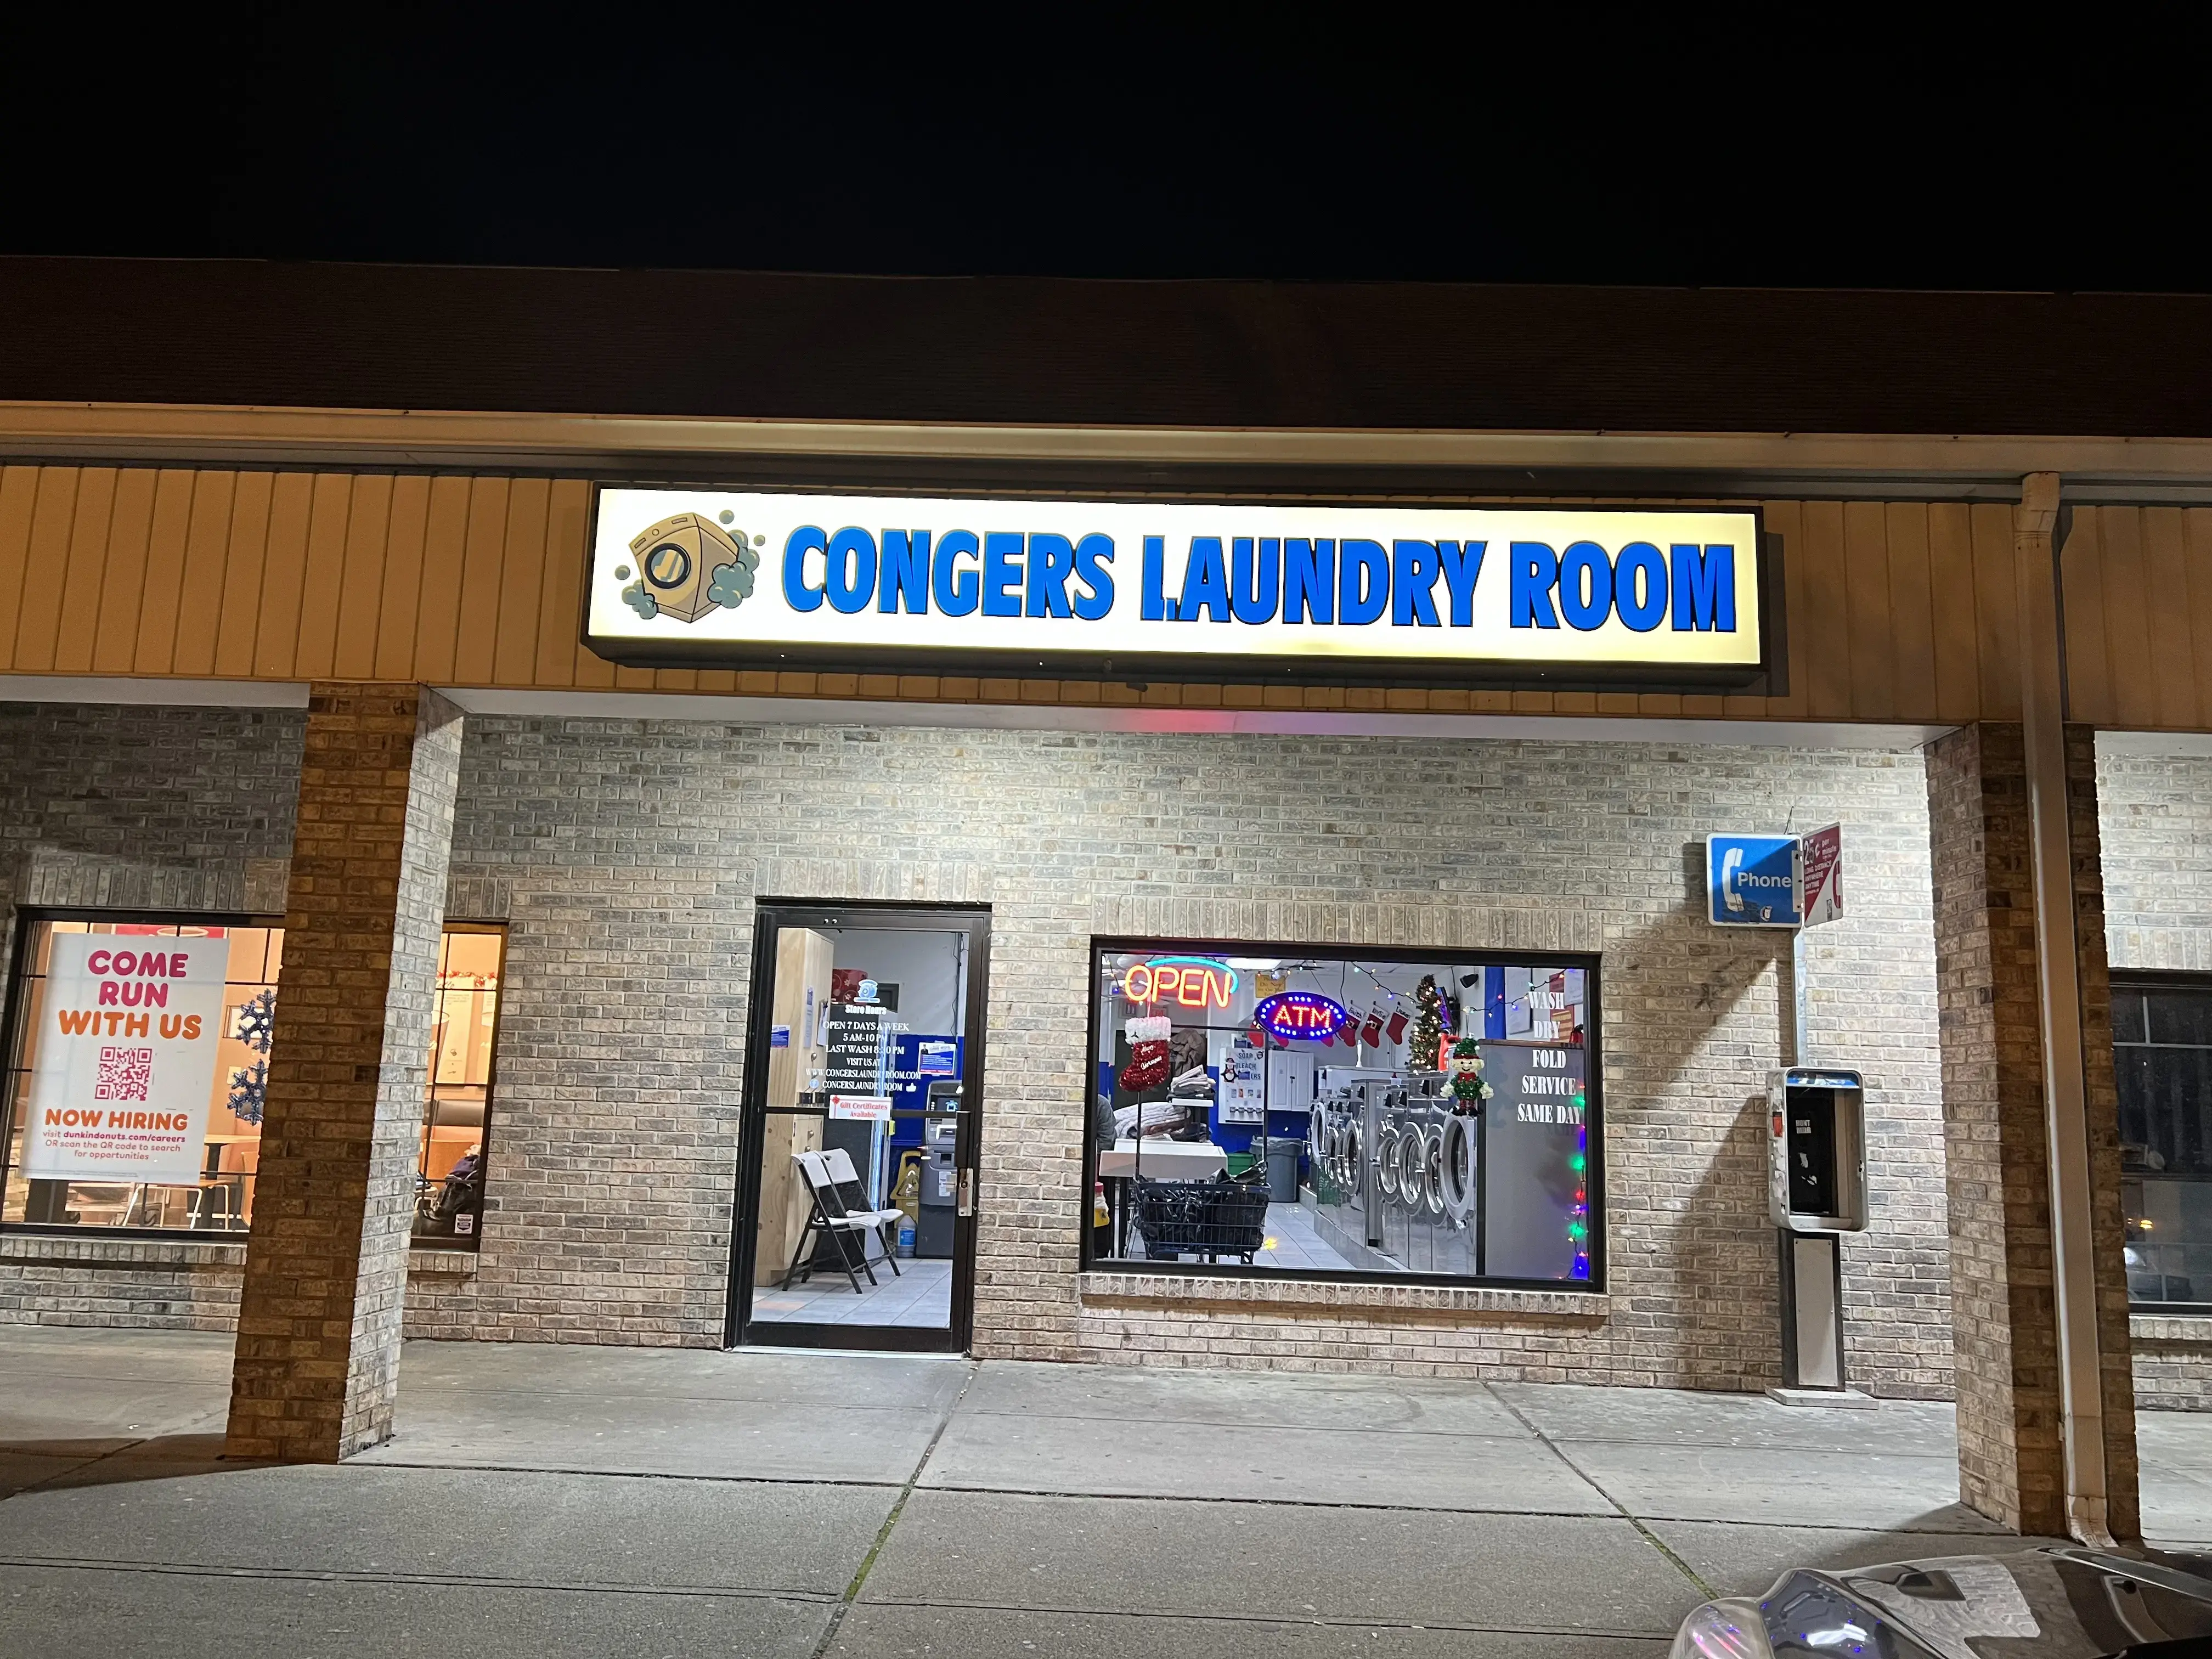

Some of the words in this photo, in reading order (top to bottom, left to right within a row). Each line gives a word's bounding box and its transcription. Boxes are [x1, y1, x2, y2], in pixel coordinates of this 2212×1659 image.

[782, 525, 1115, 620] CONGERS
[1140, 534, 1488, 628] LAUNDRY
[1510, 540, 1737, 633] ROOM
[1738, 872, 1792, 888] Phone
[88, 950, 189, 978] COME
[99, 981, 168, 1008] RUN
[1125, 965, 1231, 1008] OPEN
[845, 1005, 865, 1014] Store
[865, 1005, 887, 1015] Hours
[1528, 991, 1565, 1010] WASH
[58, 1010, 150, 1038] WITH
[159, 1014, 201, 1040] US
[823, 1021, 845, 1029] OPEN
[847, 1022, 853, 1030] 7
[884, 1023, 910, 1031] WEEK
[1273, 1005, 1331, 1029] ATM
[843, 1033, 848, 1041] 5
[1534, 1020, 1561, 1039] DRY
[826, 1045, 846, 1053] LAST
[848, 1045, 872, 1053] WASH
[892, 1046, 905, 1054] PM
[1532, 1049, 1566, 1068] FOLD
[1522, 1075, 1576, 1096] SERVICE
[45, 1108, 103, 1127] NOW
[108, 1111, 188, 1131] HIRING
[1517, 1103, 1553, 1123] SAME
[1556, 1105, 1581, 1125] DAY
[63, 1131, 185, 1142] dunkindonuts.com/careers
[89, 1151, 149, 1160] opportunities
